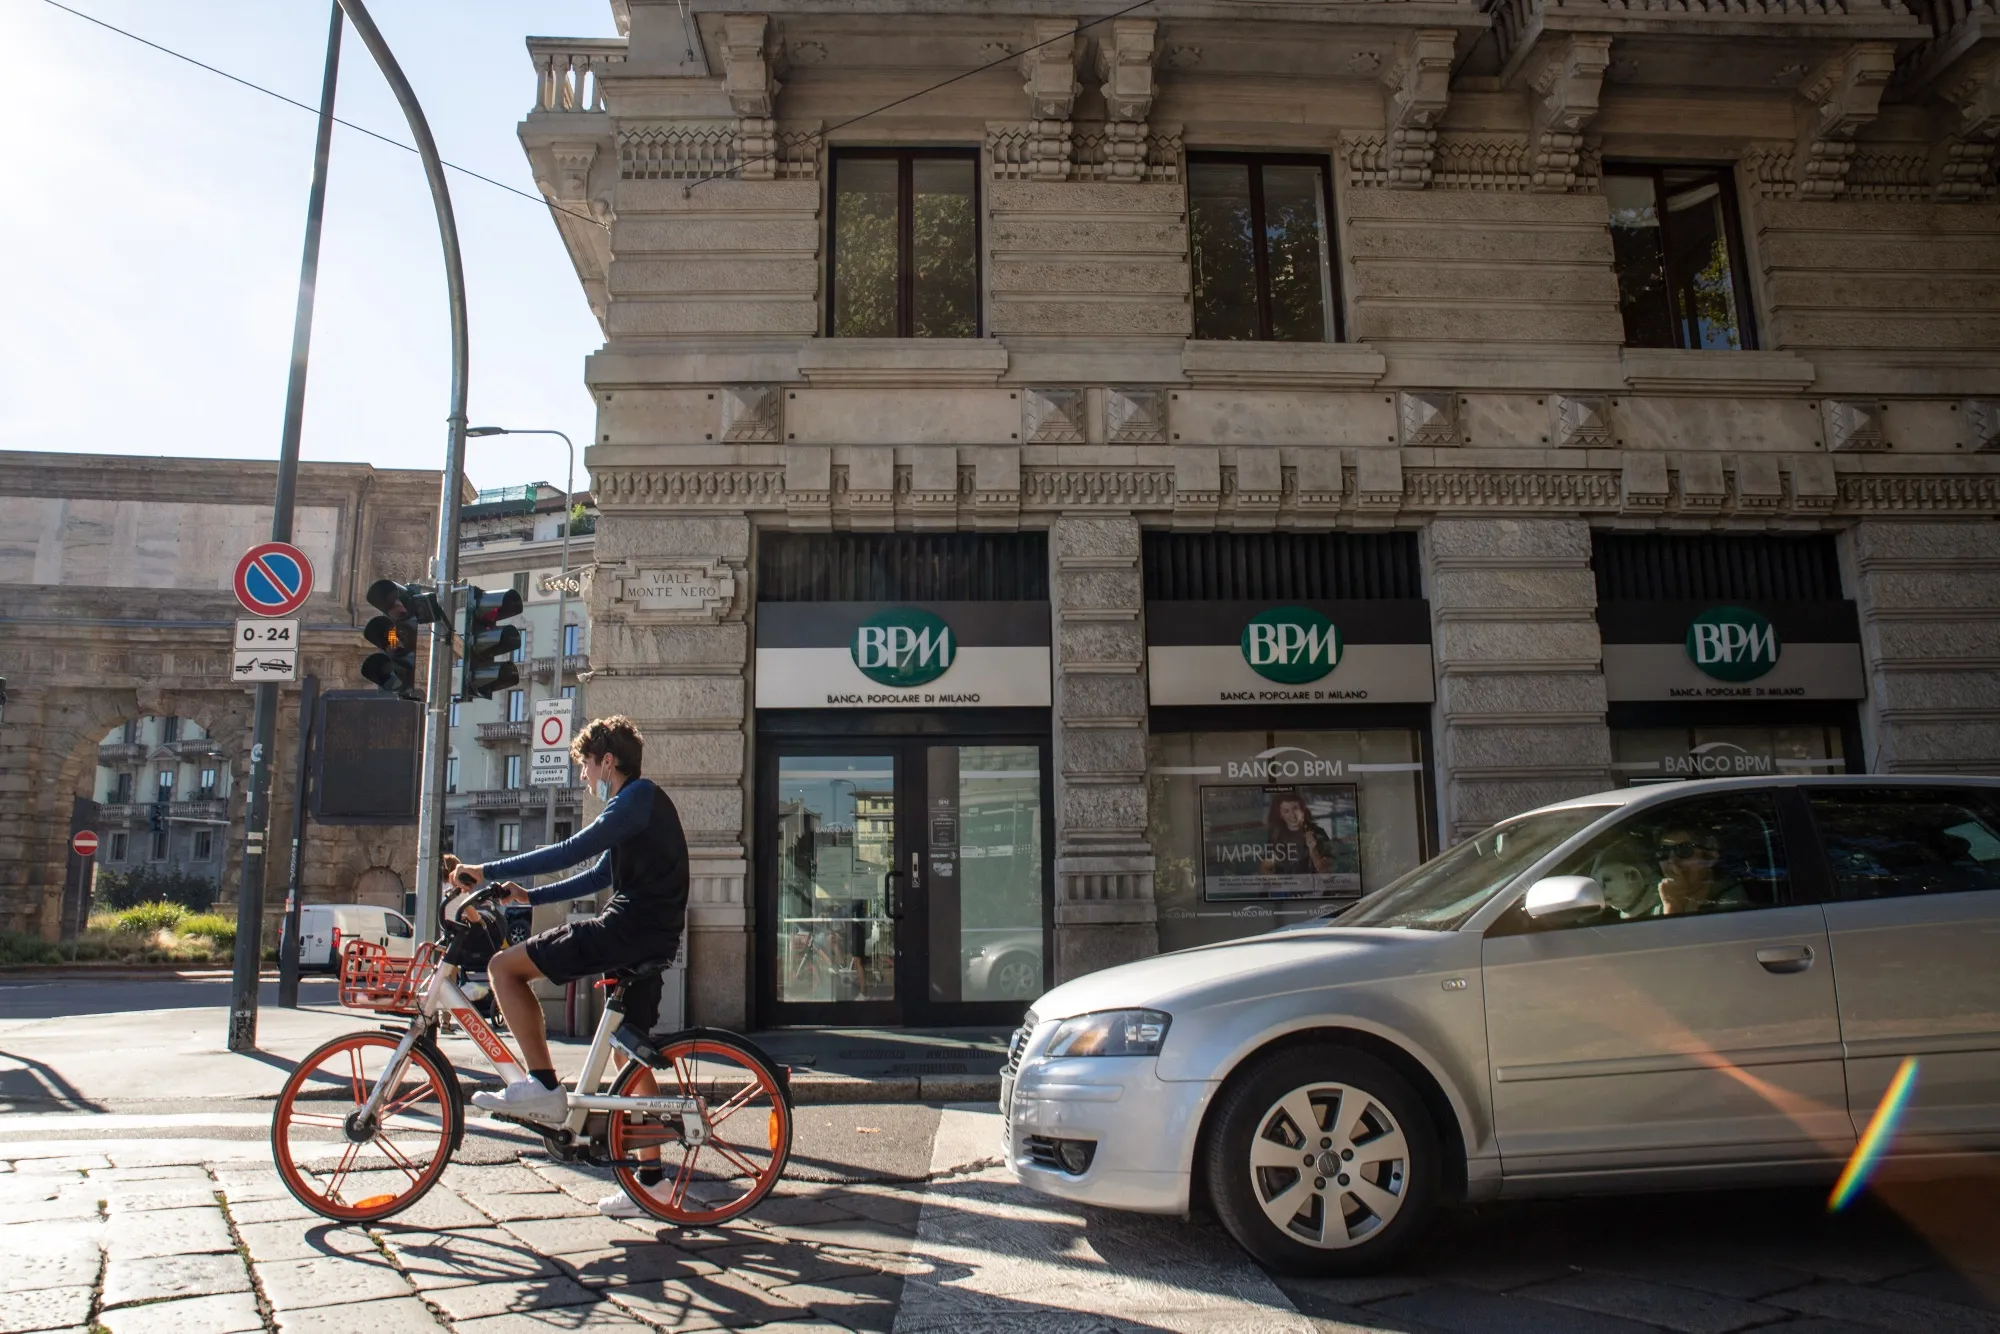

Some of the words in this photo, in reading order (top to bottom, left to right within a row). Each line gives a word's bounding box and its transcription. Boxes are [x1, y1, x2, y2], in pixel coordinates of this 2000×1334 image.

[653, 574, 692, 584] VIALE
[627, 587, 673, 597] MONTE
[681, 587, 716, 597] NERO
[243, 627, 255, 641] 0
[267, 627, 290, 641] 24
[858, 626, 949, 668] BPM
[1249, 623, 1337, 665] BPM
[1693, 623, 1777, 663] BPM
[827, 694, 863, 704] BANCA
[867, 694, 920, 703] POPOLARE
[924, 694, 935, 703] DI
[938, 693, 981, 703] MILANO
[1220, 691, 1255, 700] BANCA
[1260, 691, 1310, 700] POPOLARE
[1314, 691, 1324, 699] DI
[1328, 690, 1368, 699] MILANO
[1669, 688, 1702, 696] BANCA
[1705, 688, 1752, 696] POPOLARE
[1756, 687, 1765, 696] DI
[1768, 687, 1805, 696] MILANO
[539, 754, 551, 764] 50
[1665, 755, 1731, 773] BANCO
[1735, 755, 1771, 771] BPM
[1227, 761, 1299, 778] BANCO
[1304, 760, 1343, 777] BPM
[1216, 843, 1298, 863] IMPRESE
[1232, 910, 1258, 918] BANCO
[461, 1013, 502, 1057] mobike
